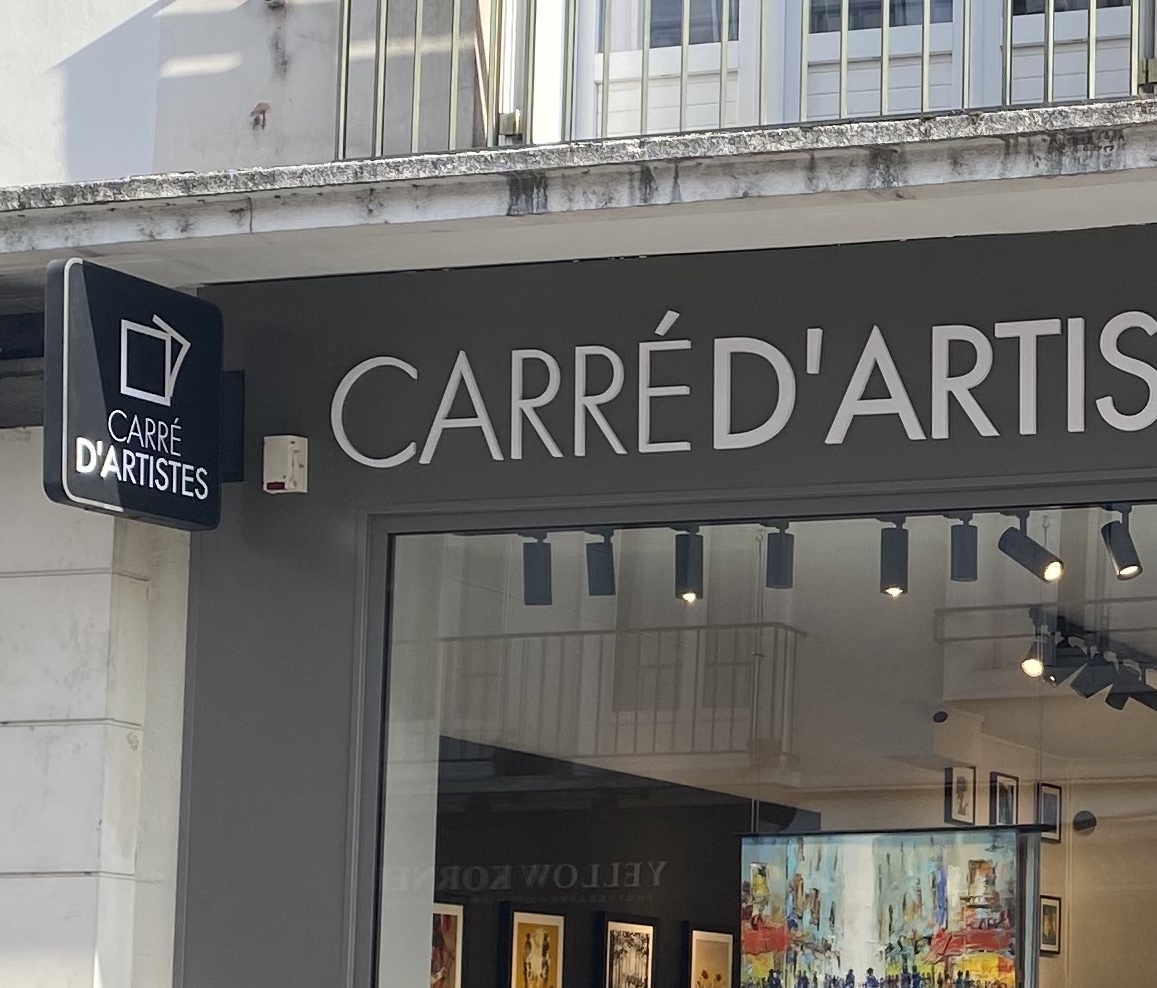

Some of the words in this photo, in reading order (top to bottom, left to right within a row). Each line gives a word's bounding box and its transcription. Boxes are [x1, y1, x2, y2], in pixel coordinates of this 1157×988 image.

[331, 310, 692, 468] CARRÉ
[107, 409, 182, 457] CARRÉ
[75, 436, 209, 501] D'ARTISTES
